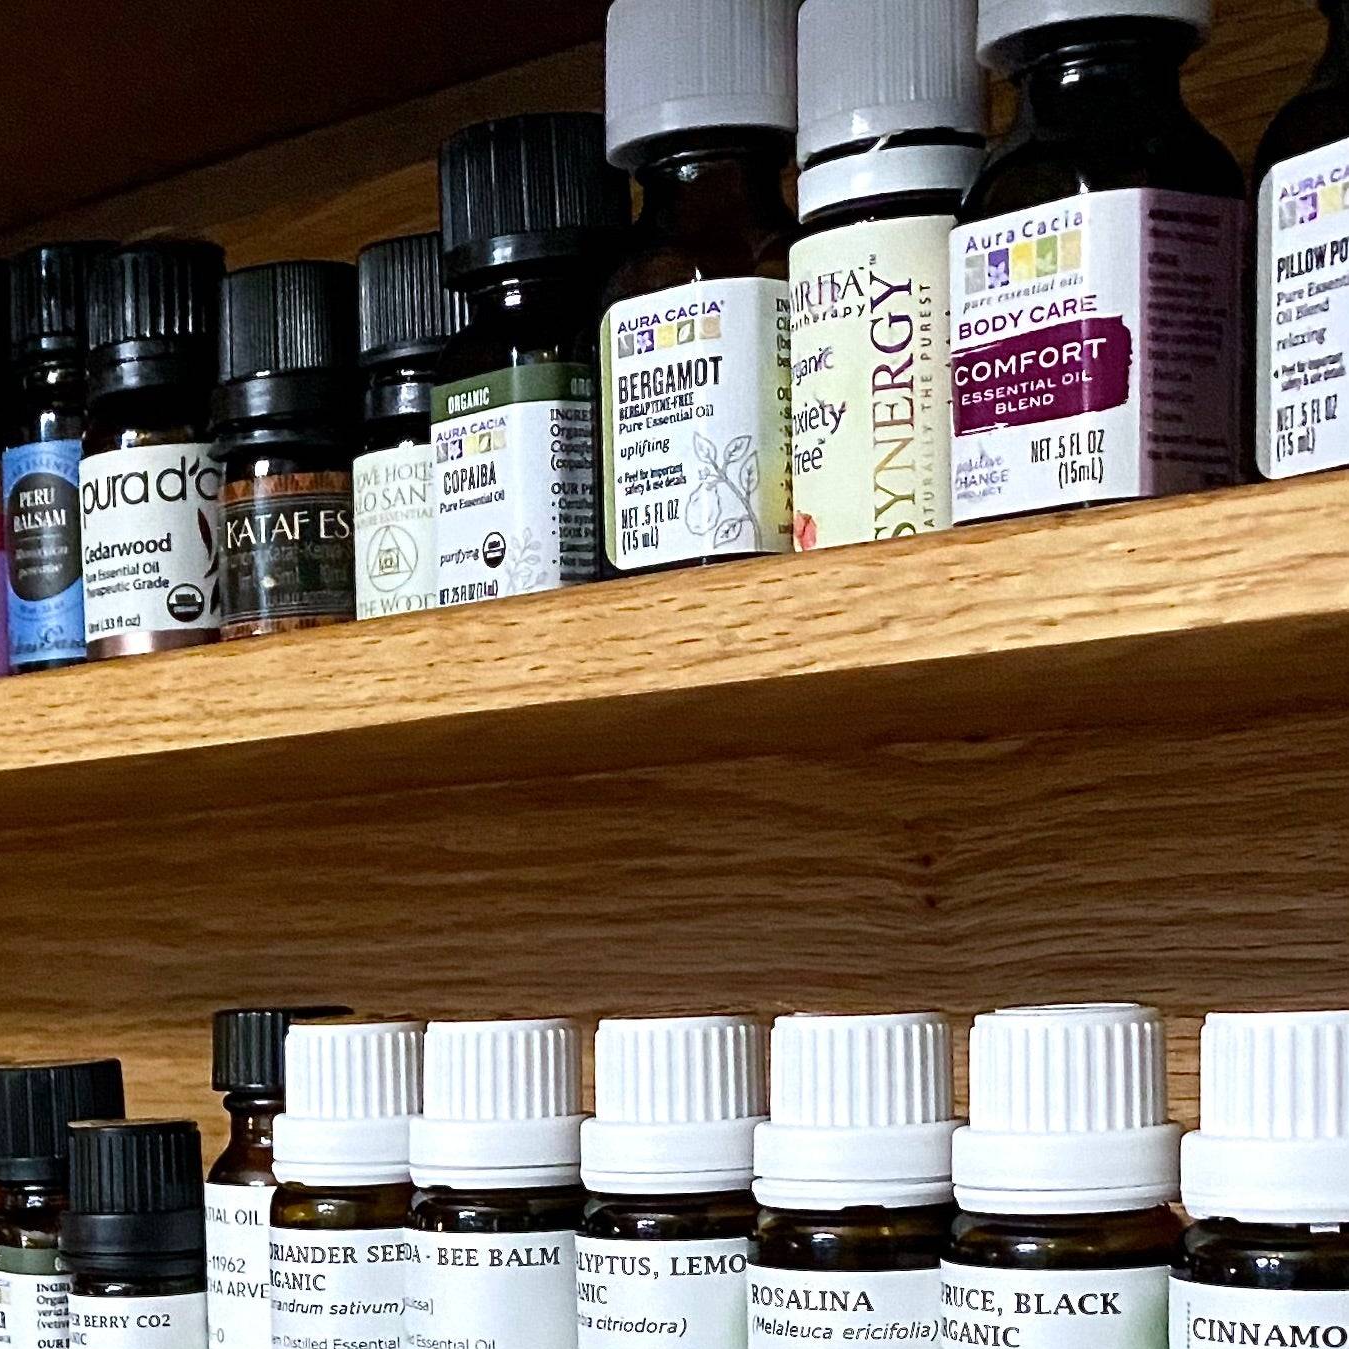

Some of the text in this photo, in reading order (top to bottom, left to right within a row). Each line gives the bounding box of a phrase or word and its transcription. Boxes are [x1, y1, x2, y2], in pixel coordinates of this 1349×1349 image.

[1279, 175, 1325, 200] AURA
[966, 210, 1083, 253] Aura Cacia
[1277, 242, 1325, 283] PILLOW
[997, 282, 1055, 304] essential
[617, 314, 661, 333] AURA
[920, 283, 932, 360] PUREST
[959, 295, 1097, 339] BODY CARE
[954, 339, 1106, 386] COMFORT
[618, 356, 723, 404] BERGAMOT
[962, 369, 1093, 406] ESSENTIAL OIL
[448, 387, 490, 414] ORGANIC
[996, 394, 1054, 415] BLEND
[619, 405, 714, 435] Pure Essential Oil
[436, 428, 467, 442] AURA
[1031, 437, 1051, 464] NET
[1070, 433, 1082, 456] FL
[1088, 429, 1105, 453] OZ
[620, 437, 670, 459] uplifting
[444, 461, 497, 495] COPAIBA
[1059, 458, 1104, 488] (15mL)
[19, 487, 56, 507] PERU
[82, 471, 148, 528] pura
[440, 501, 457, 514] Pure
[13, 508, 66, 532] BALSAM
[621, 504, 638, 529] NET
[227, 511, 310, 549] KATAF
[85, 532, 172, 565] Cedarwood
[98, 561, 159, 583] Essential Oil
[133, 576, 170, 590] Grade
[235, 1209, 264, 1226] OIL
[437, 1247, 560, 1267] BEE BALM
[329, 1301, 405, 1316] sativum)
[752, 1283, 874, 1312] ROSALINA
[1014, 1292, 1122, 1315] BLACK
[84, 1314, 171, 1327] BERRY CO2
[597, 1317, 687, 1338] citriodora)
[752, 1317, 940, 1342] (Melaleuca ericifolia)
[1192, 1317, 1347, 1349] CINNAMO
[283, 1335, 400, 1349] Distilled Essential
